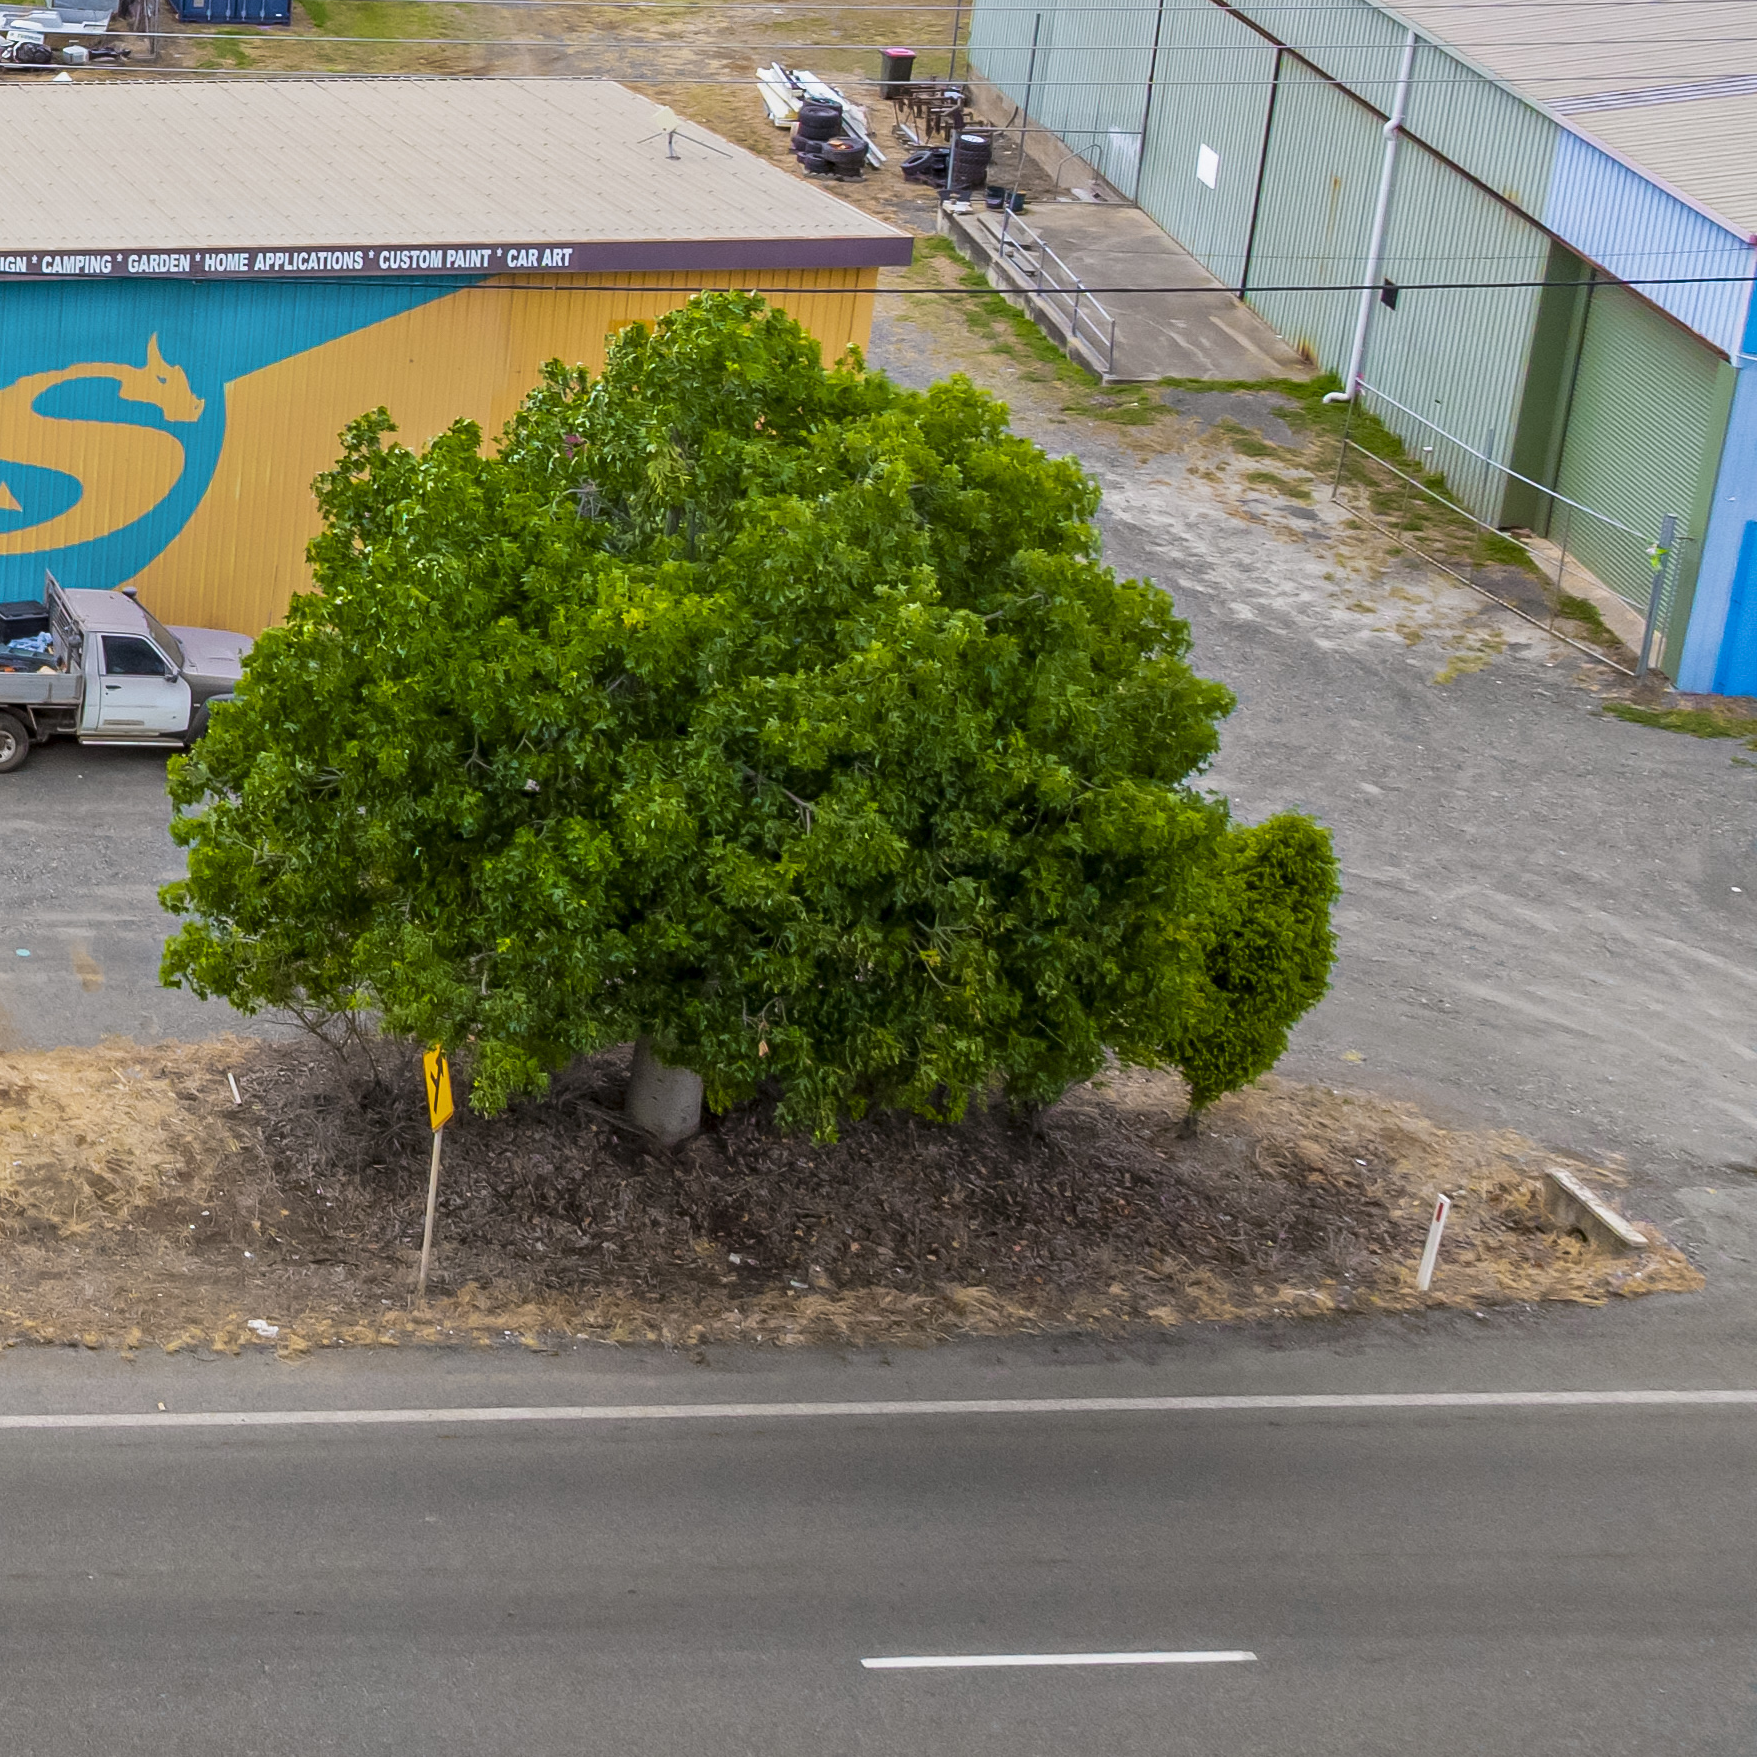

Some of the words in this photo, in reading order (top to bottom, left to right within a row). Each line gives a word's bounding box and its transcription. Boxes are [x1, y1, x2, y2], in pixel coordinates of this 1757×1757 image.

[41, 254, 112, 274] CAMPING
[127, 254, 190, 273] GARDEN
[204, 253, 249, 271] HOME
[254, 251, 364, 270] APPLICATIONS
[379, 250, 443, 269] CUSTOM
[446, 249, 491, 268] PAINT
[507, 249, 538, 267] CAR
[541, 248, 573, 266] ART
